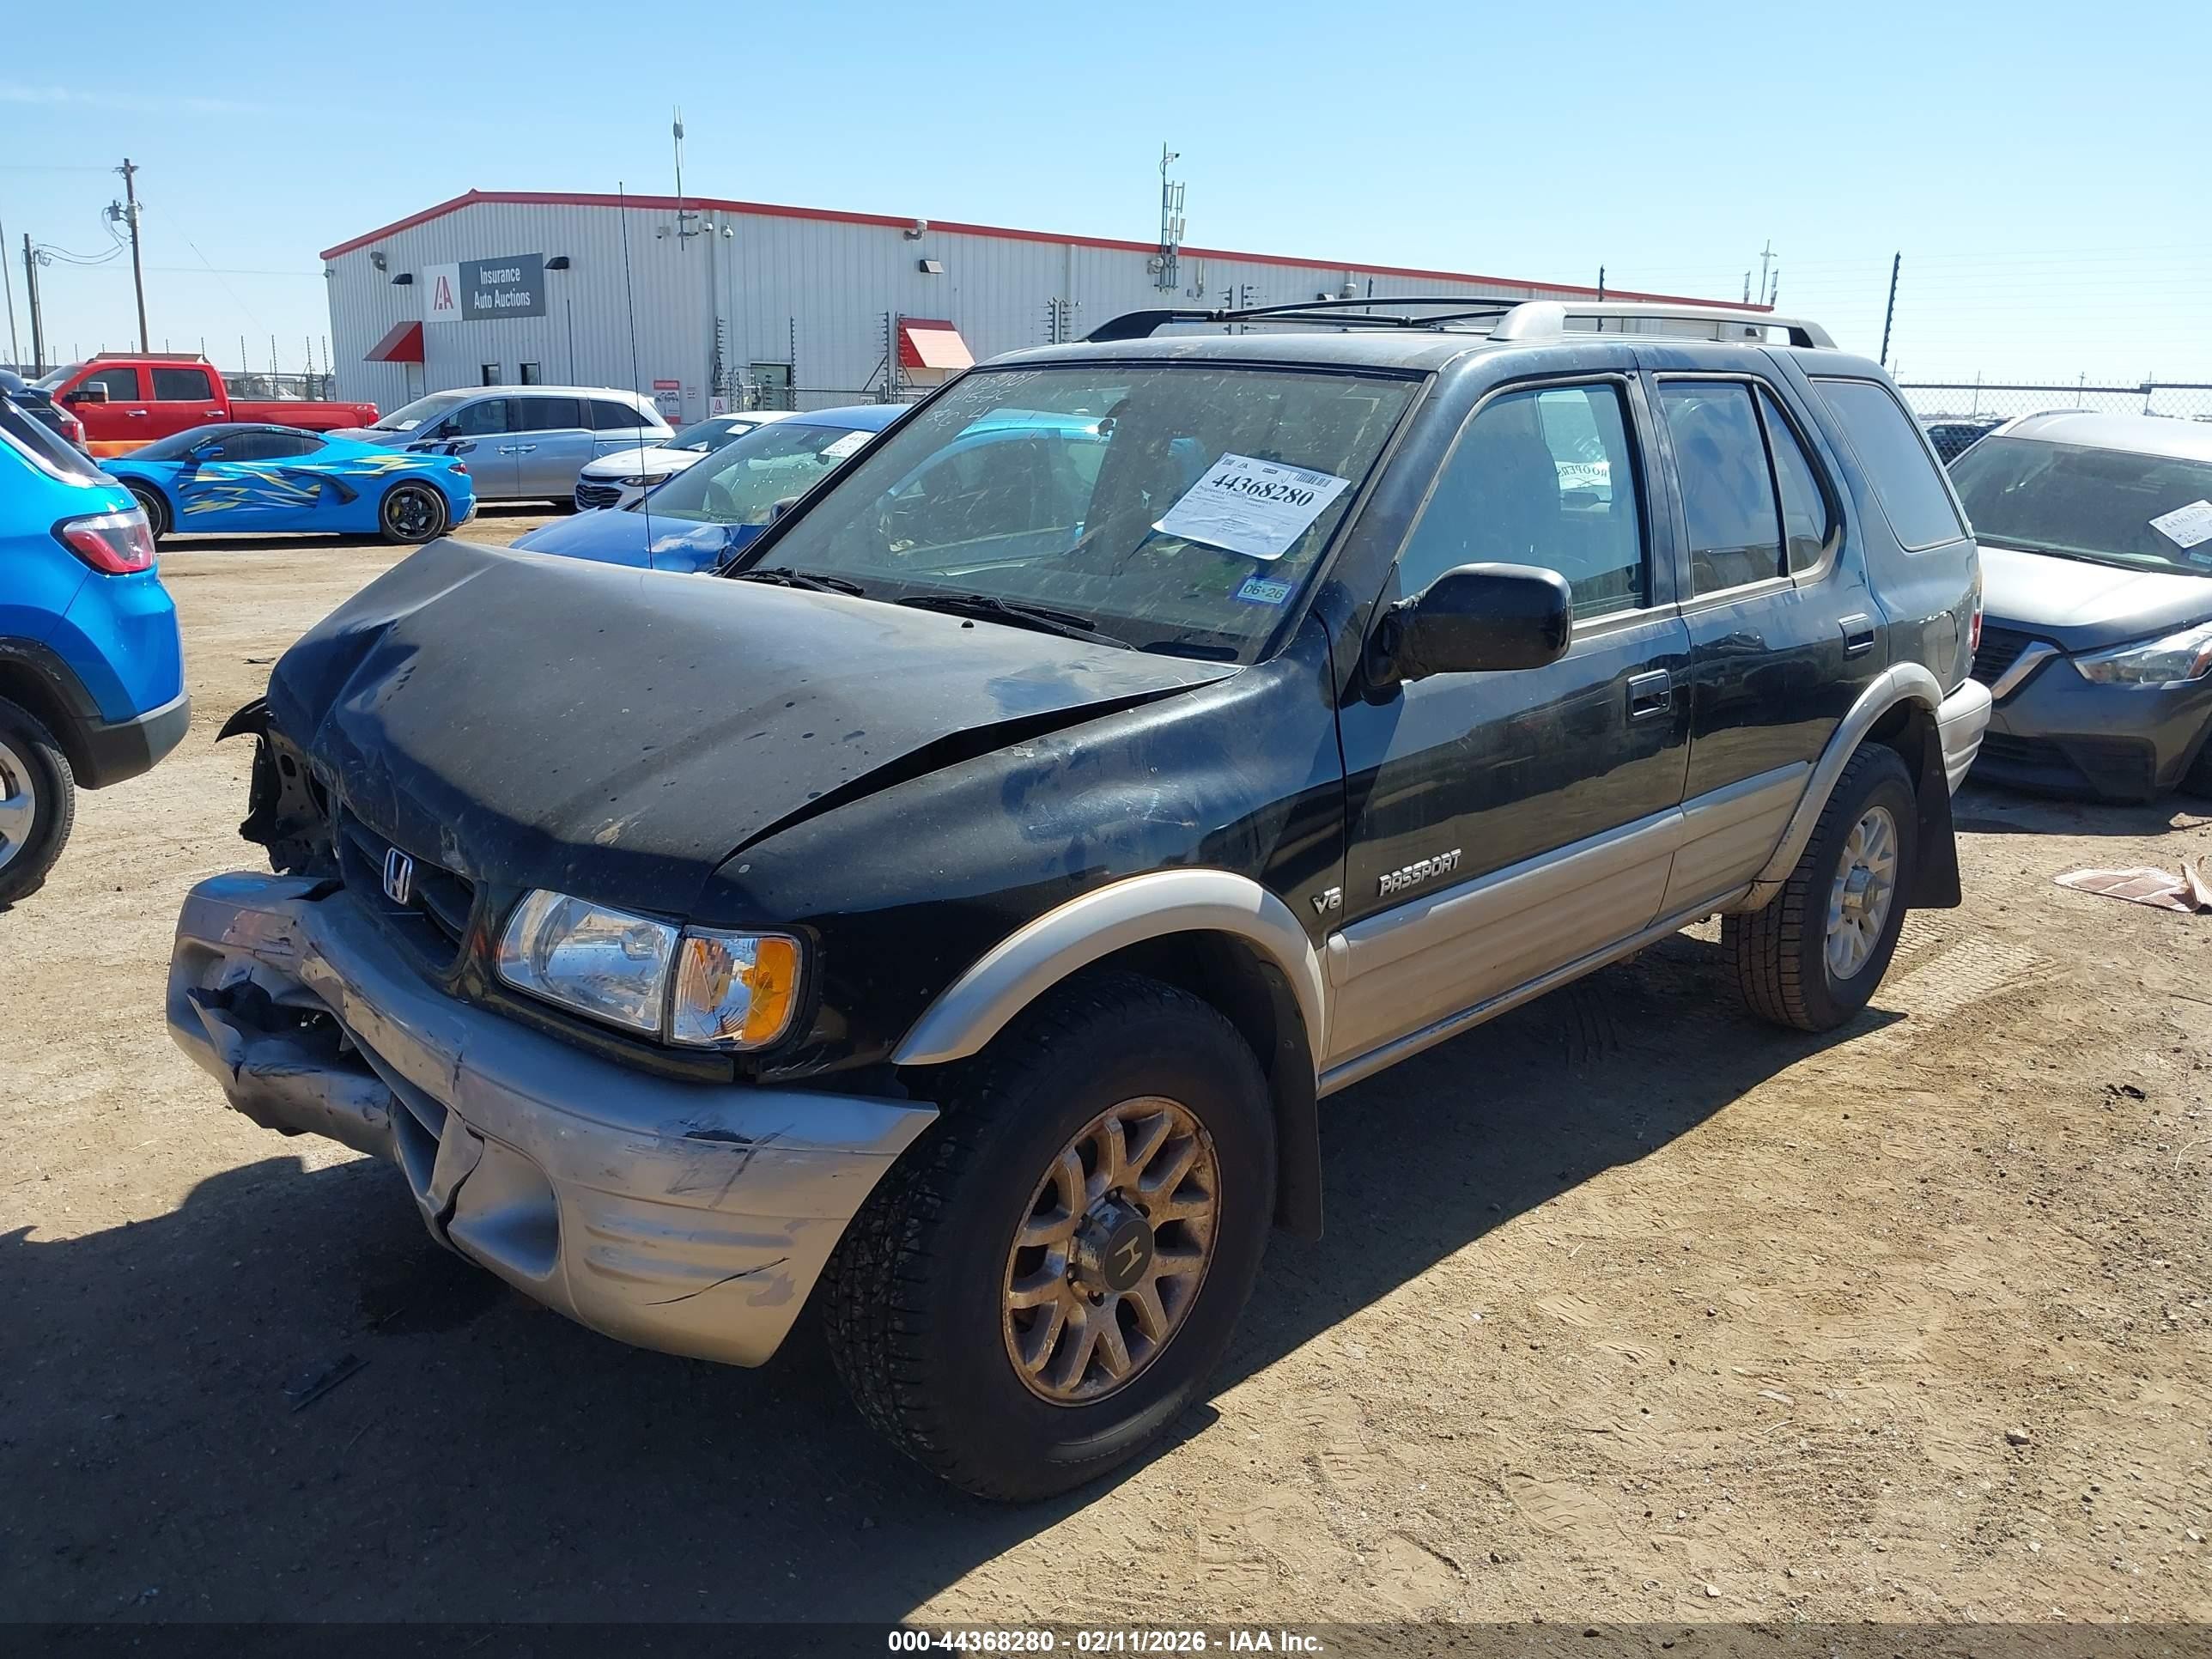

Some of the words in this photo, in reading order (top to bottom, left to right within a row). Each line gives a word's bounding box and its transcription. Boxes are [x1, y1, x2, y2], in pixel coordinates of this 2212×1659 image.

[479, 266, 521, 285] Insurance
[474, 290, 493, 309] Auto
[494, 288, 532, 307] Auctions
[1212, 473, 1316, 507] 44368280
[1379, 848, 1462, 897] PASSPORT
[1312, 886, 1341, 915] V6
